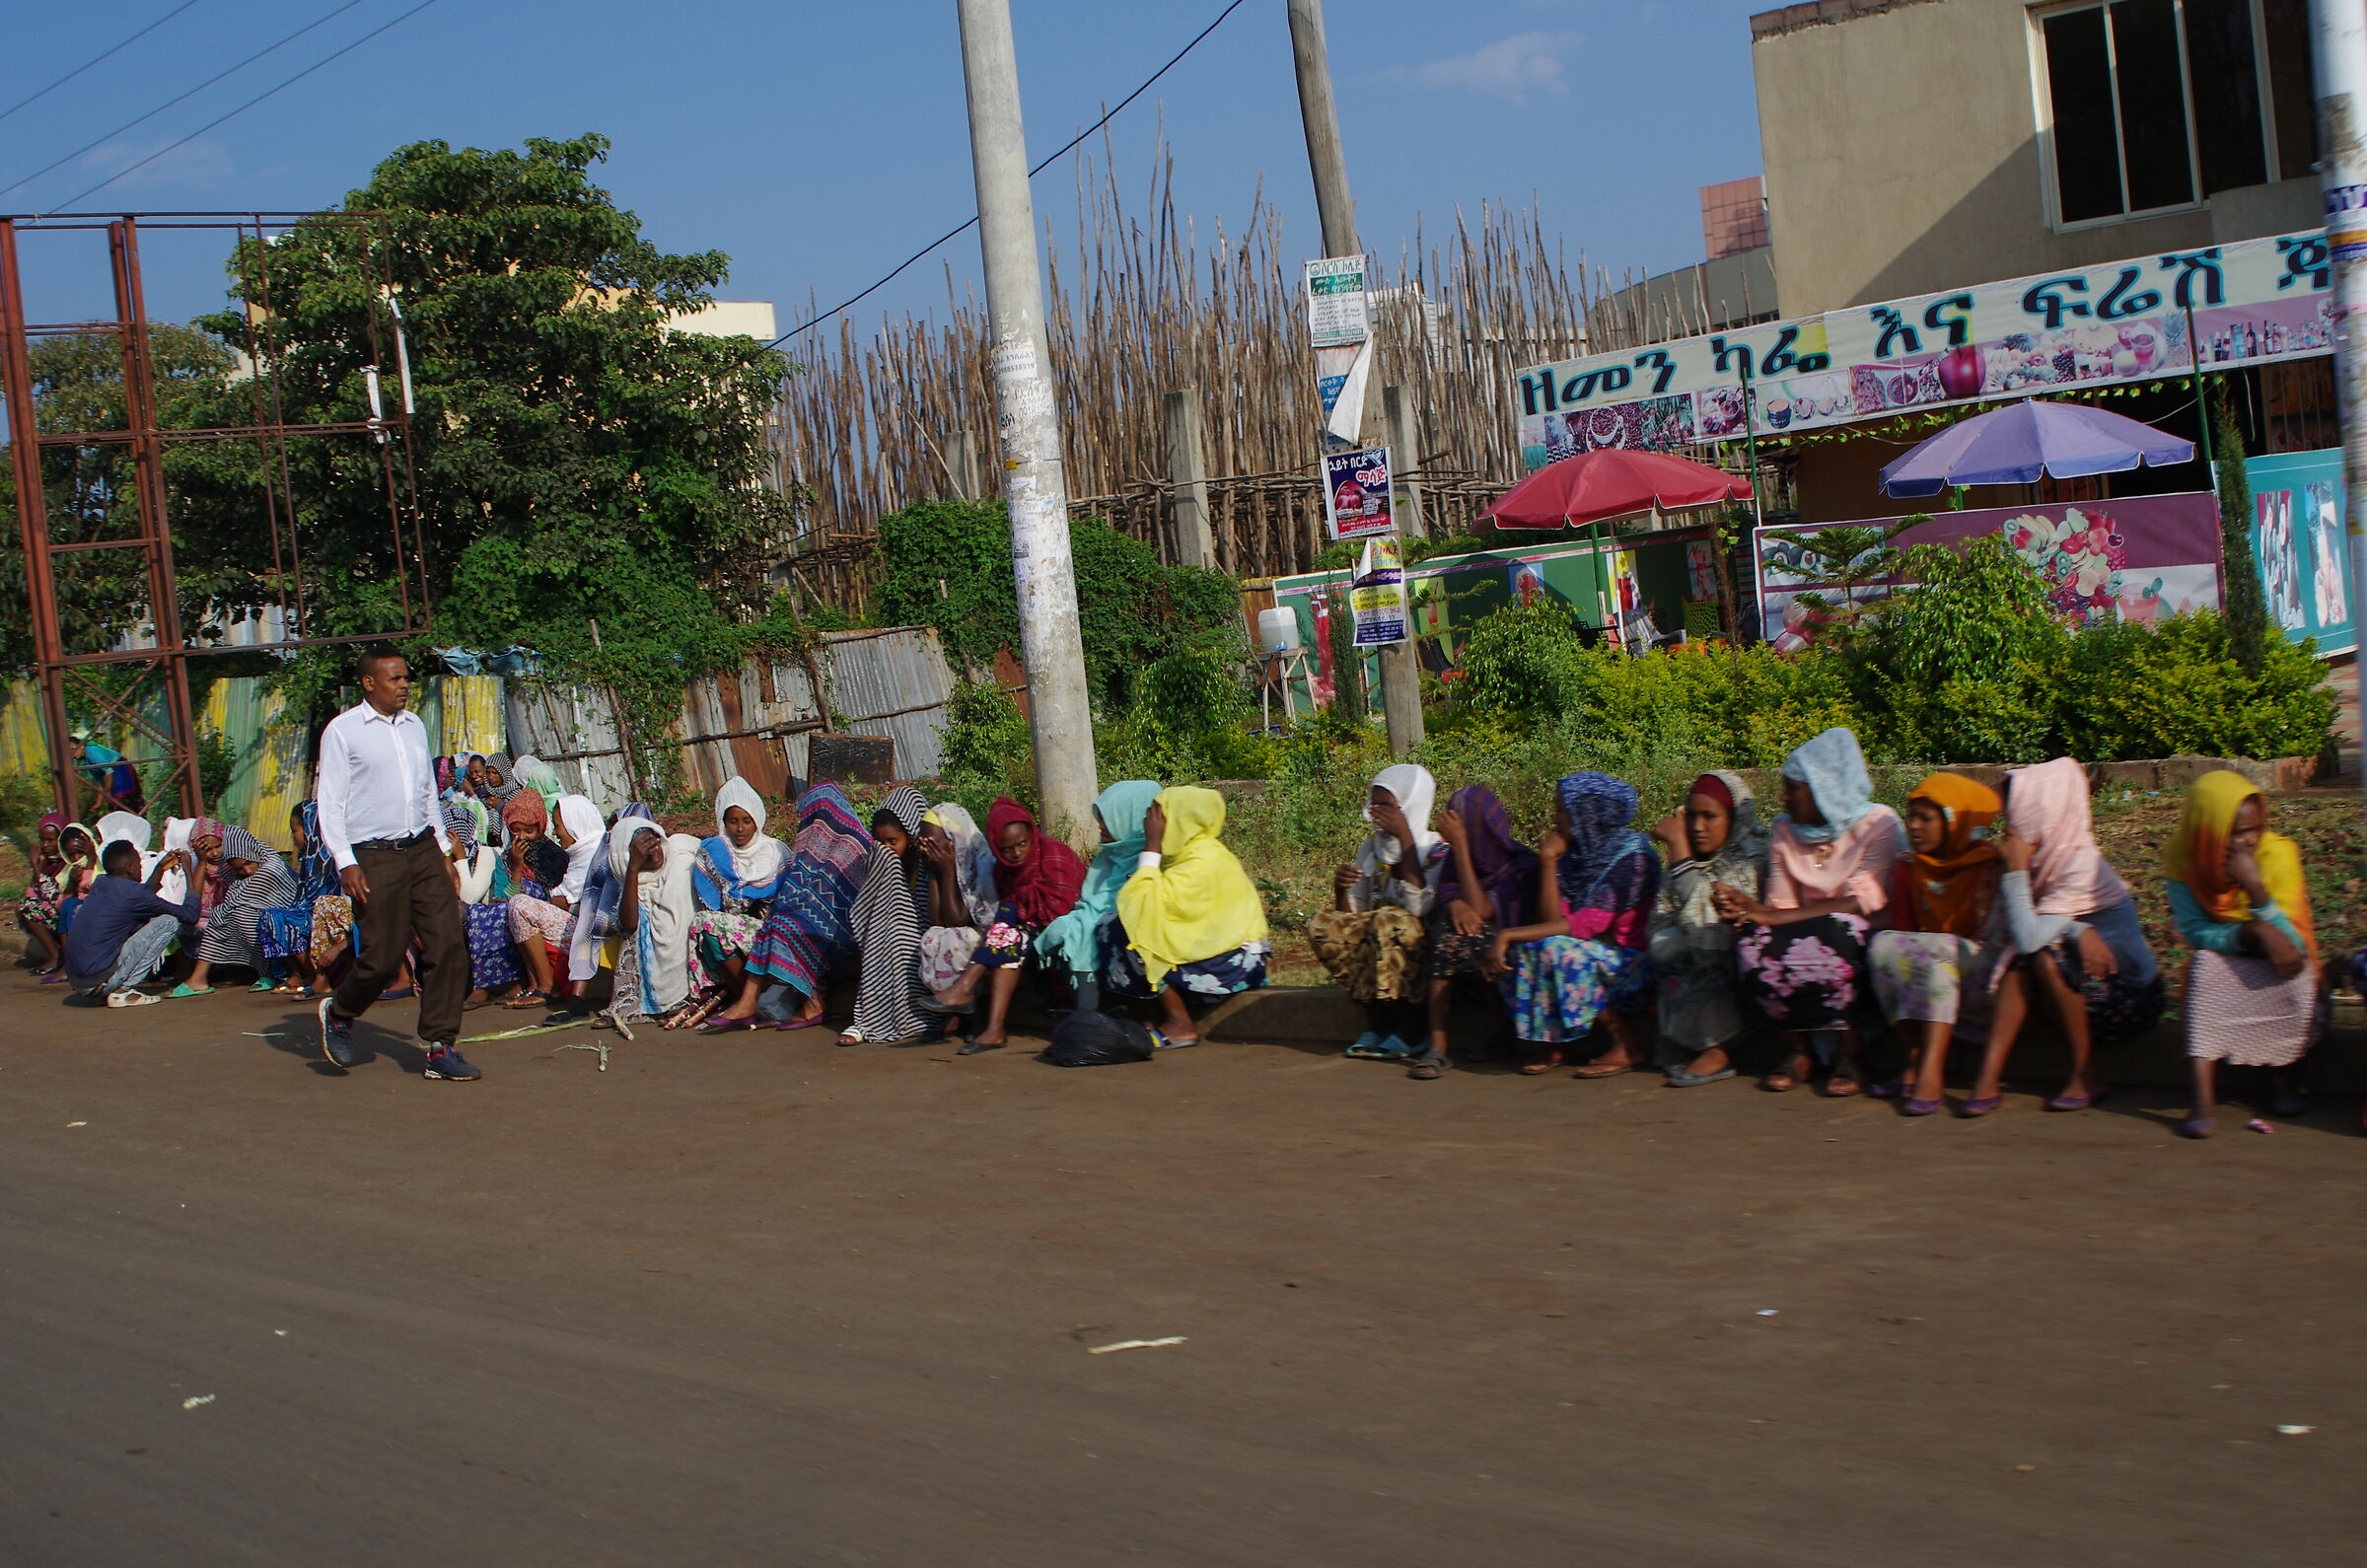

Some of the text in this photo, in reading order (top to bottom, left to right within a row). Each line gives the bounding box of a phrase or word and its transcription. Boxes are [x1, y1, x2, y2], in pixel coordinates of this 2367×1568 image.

[1519, 348, 1677, 415] ዘመን
[1710, 325, 1831, 383] ካፌ
[1870, 294, 1975, 360] እና
[2021, 247, 2227, 330] ፍሬሽ
